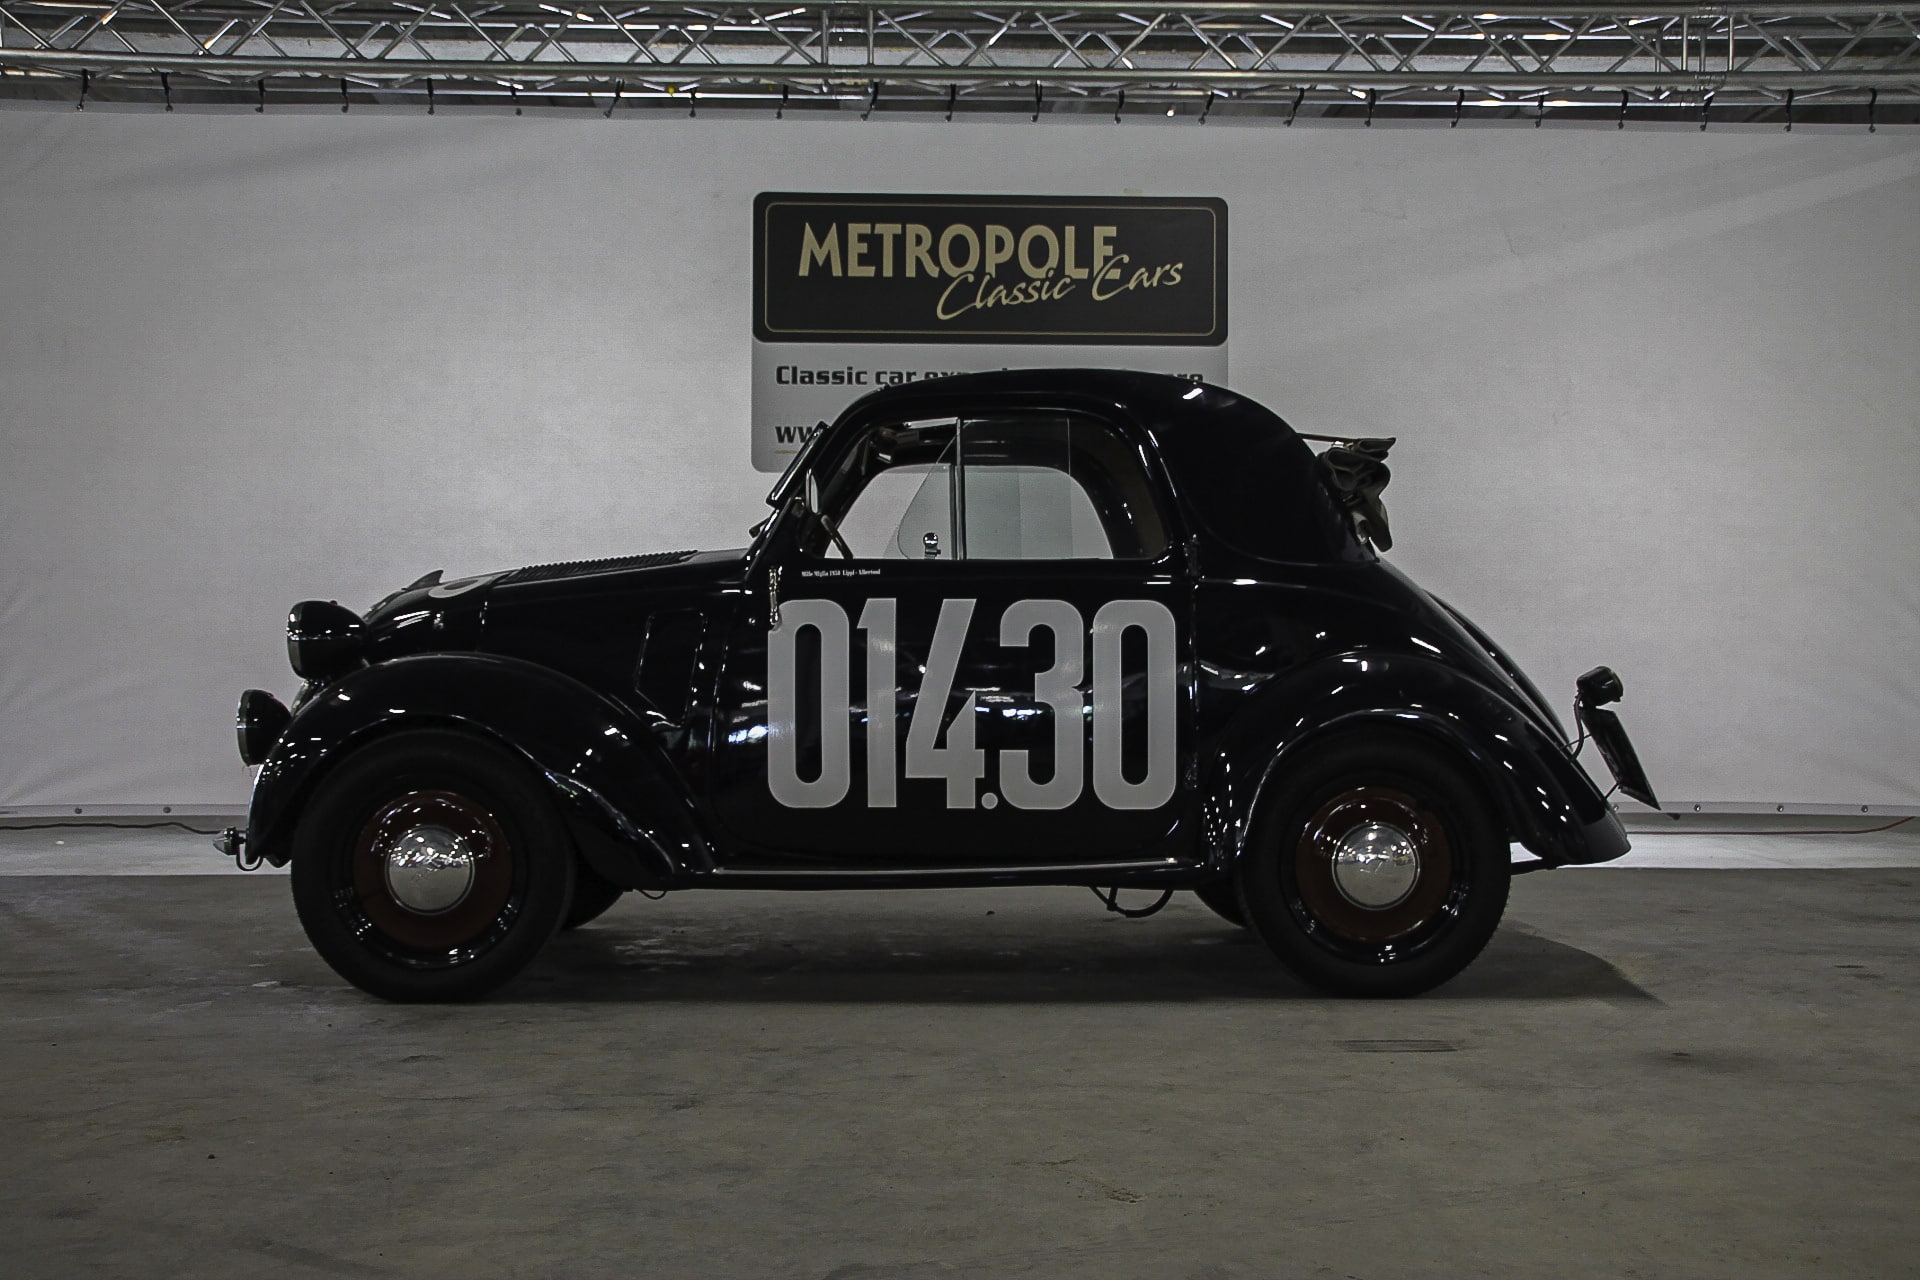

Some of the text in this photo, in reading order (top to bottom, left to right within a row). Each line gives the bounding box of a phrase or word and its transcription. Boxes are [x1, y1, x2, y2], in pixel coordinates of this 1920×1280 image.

[798, 222, 1121, 280] METROPOLE
[936, 253, 1184, 320] Classic Cars
[775, 365, 868, 386] Classic
[875, 370, 917, 386] car
[767, 597, 1177, 810] 014.30
